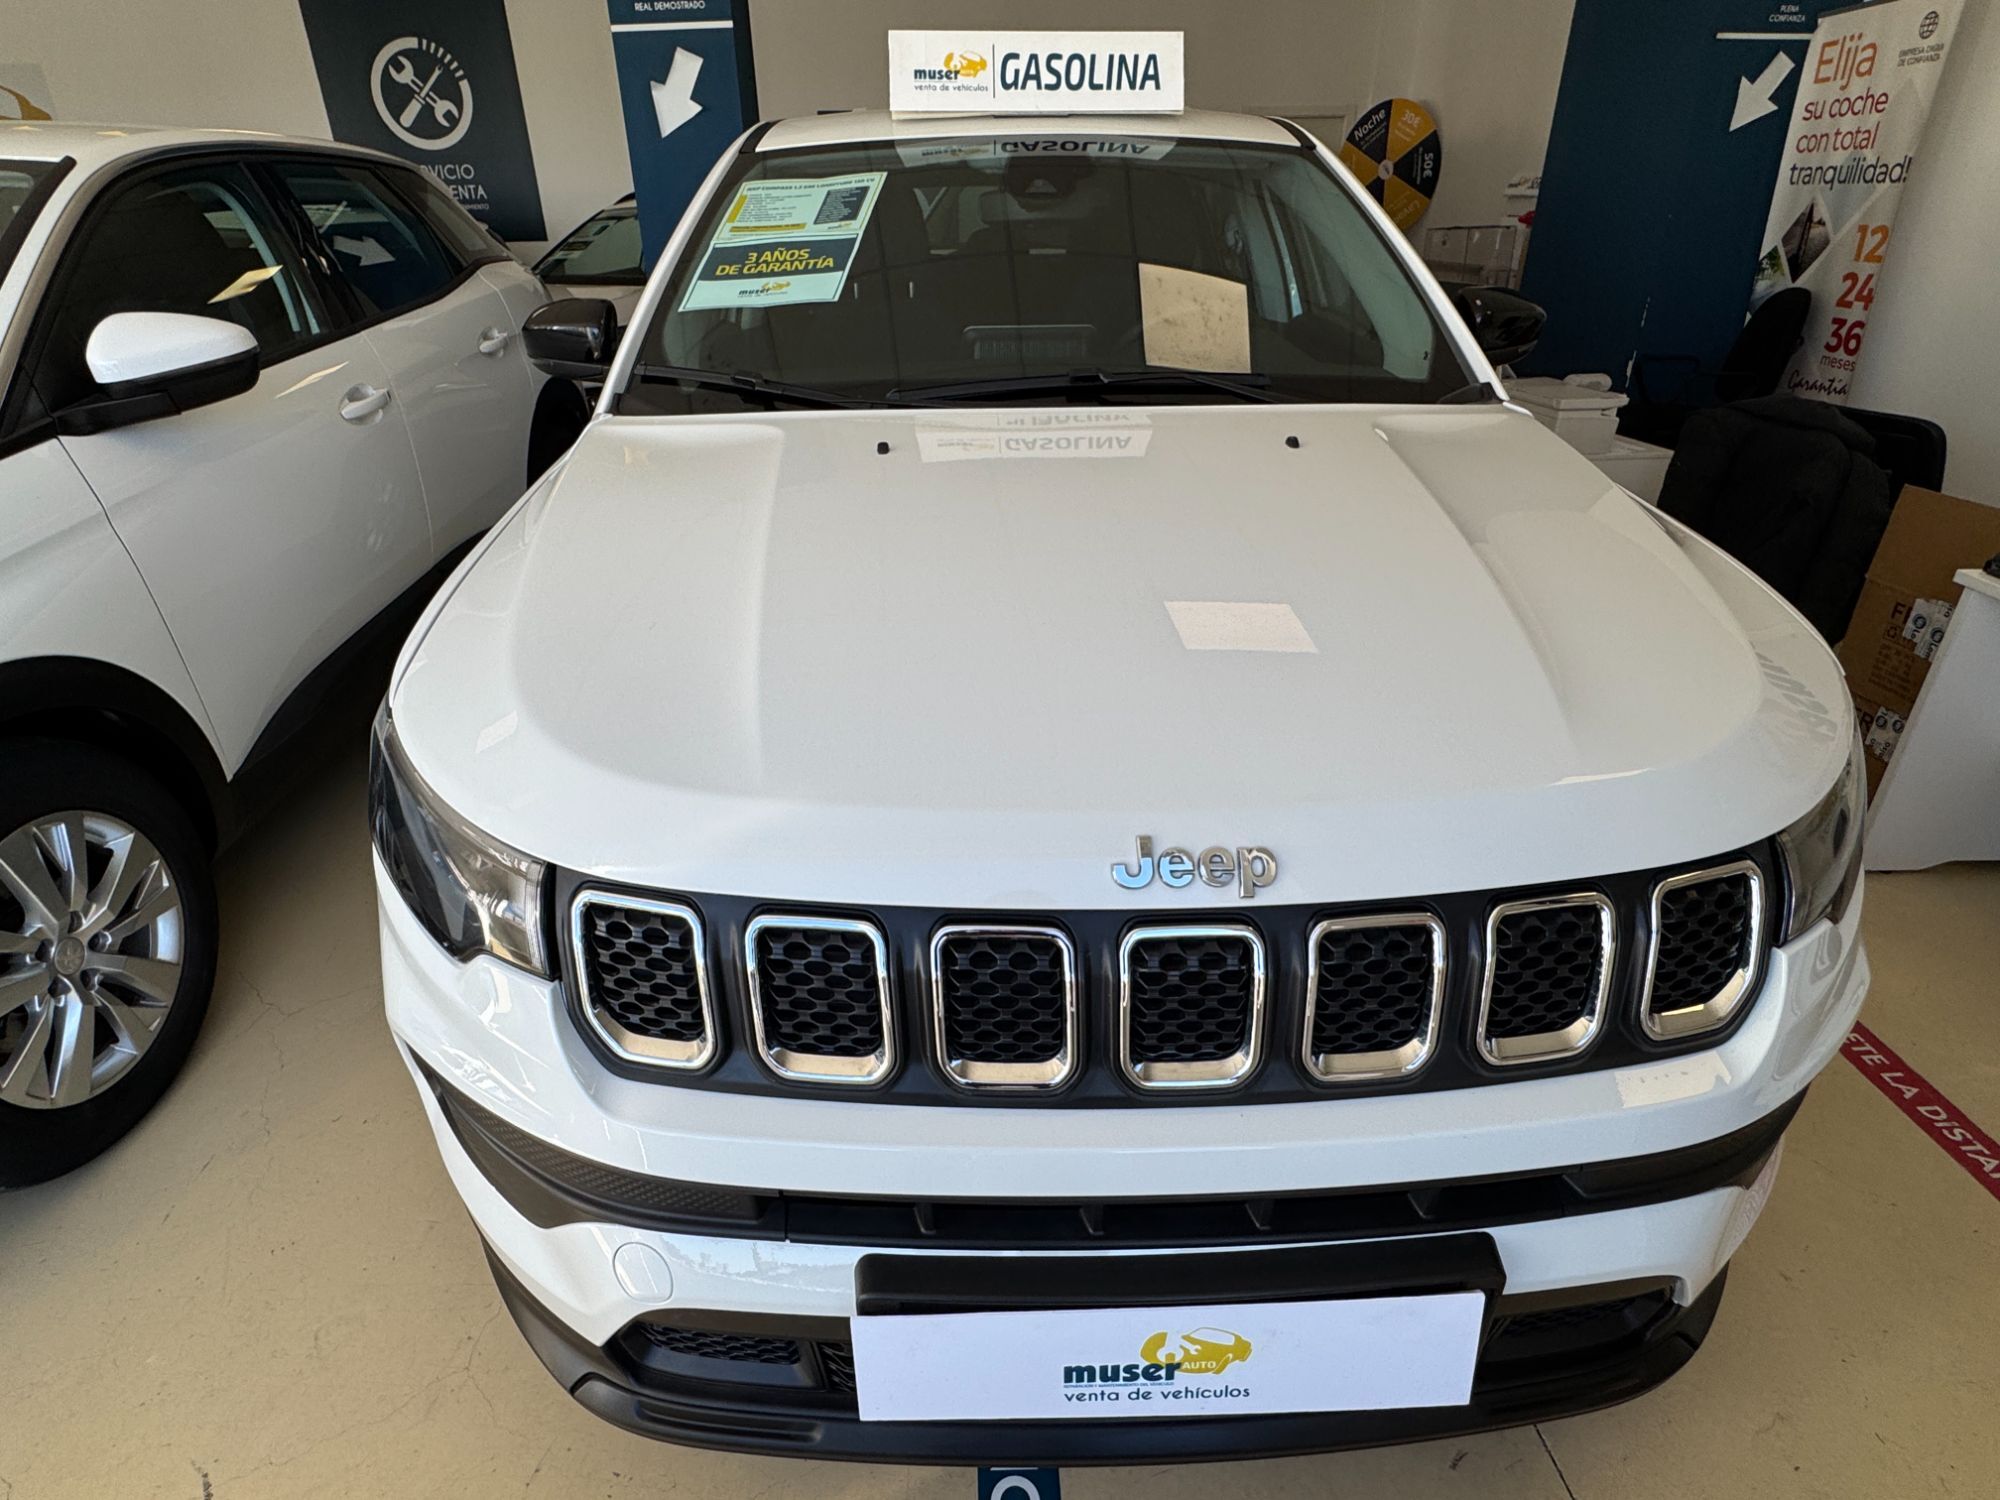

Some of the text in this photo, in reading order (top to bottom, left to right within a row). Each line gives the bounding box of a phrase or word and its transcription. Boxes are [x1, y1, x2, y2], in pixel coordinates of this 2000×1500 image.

[634, 0, 706, 11] REAL DEMOSTRADO
[1768, 14, 1806, 22] CONFIANZA
[914, 69, 961, 80] muser
[1000, 52, 1161, 91] GASOLINA
[1813, 32, 1878, 91] Elija
[939, 83, 950, 91] de
[1802, 86, 1889, 121] su coche
[1353, 109, 1386, 141] Noche
[1796, 121, 1880, 154] con total
[1789, 155, 1913, 191] tranquilidad!
[745, 248, 811, 264] 3 AÑOS
[1853, 224, 1890, 263] 12
[715, 255, 834, 276] DE GARANTÍA
[1835, 271, 1875, 311] 24
[1824, 317, 1866, 357] 36
[1819, 354, 1856, 372] meses
[1788, 369, 1849, 396] Garantía
[1111, 835, 1278, 899] Jeep
[1880, 1072, 1921, 1100] LA
[1063, 1361, 1217, 1384] muser AUTO
[1064, 1385, 1250, 1402] venta de vehículos
